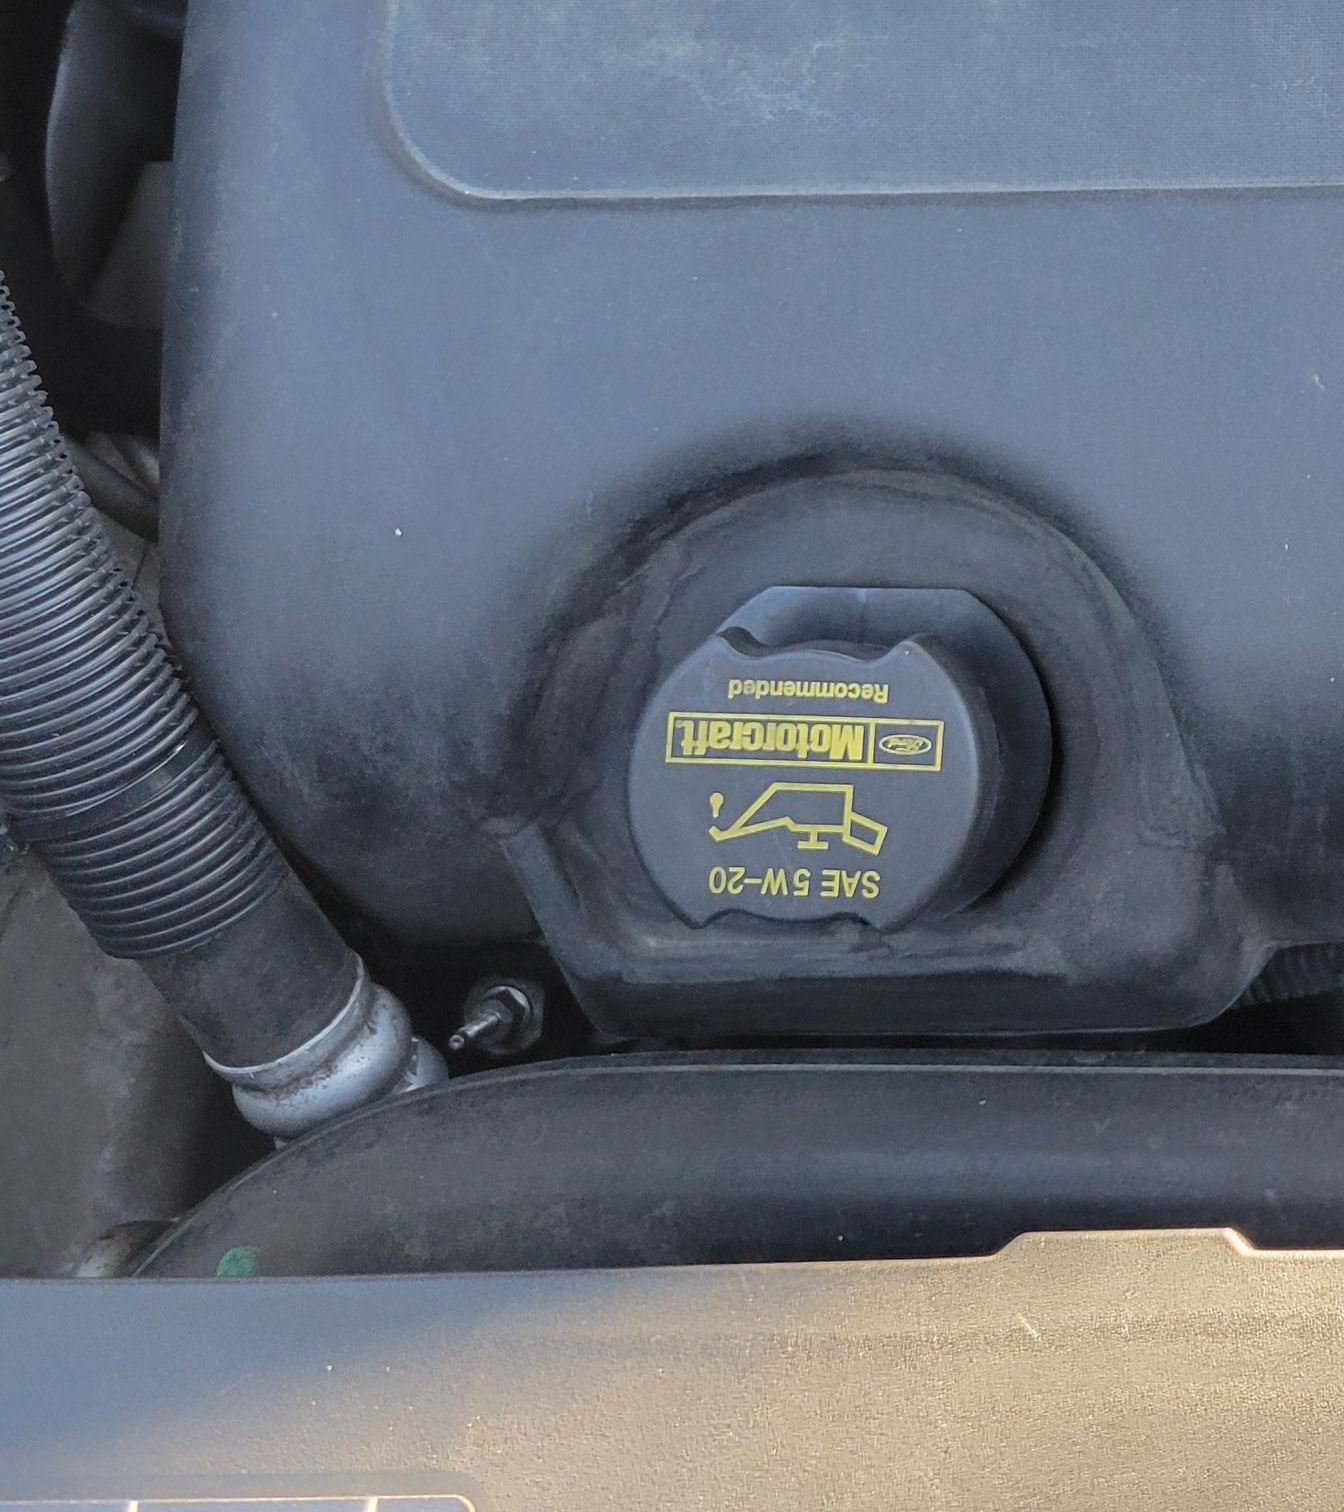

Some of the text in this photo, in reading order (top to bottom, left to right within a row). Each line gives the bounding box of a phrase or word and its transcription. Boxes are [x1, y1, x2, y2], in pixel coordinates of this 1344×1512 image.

[727, 678, 890, 705] Recommended
[676, 720, 865, 762] Motorcraft
[708, 865, 882, 899] SAE 5W-20
